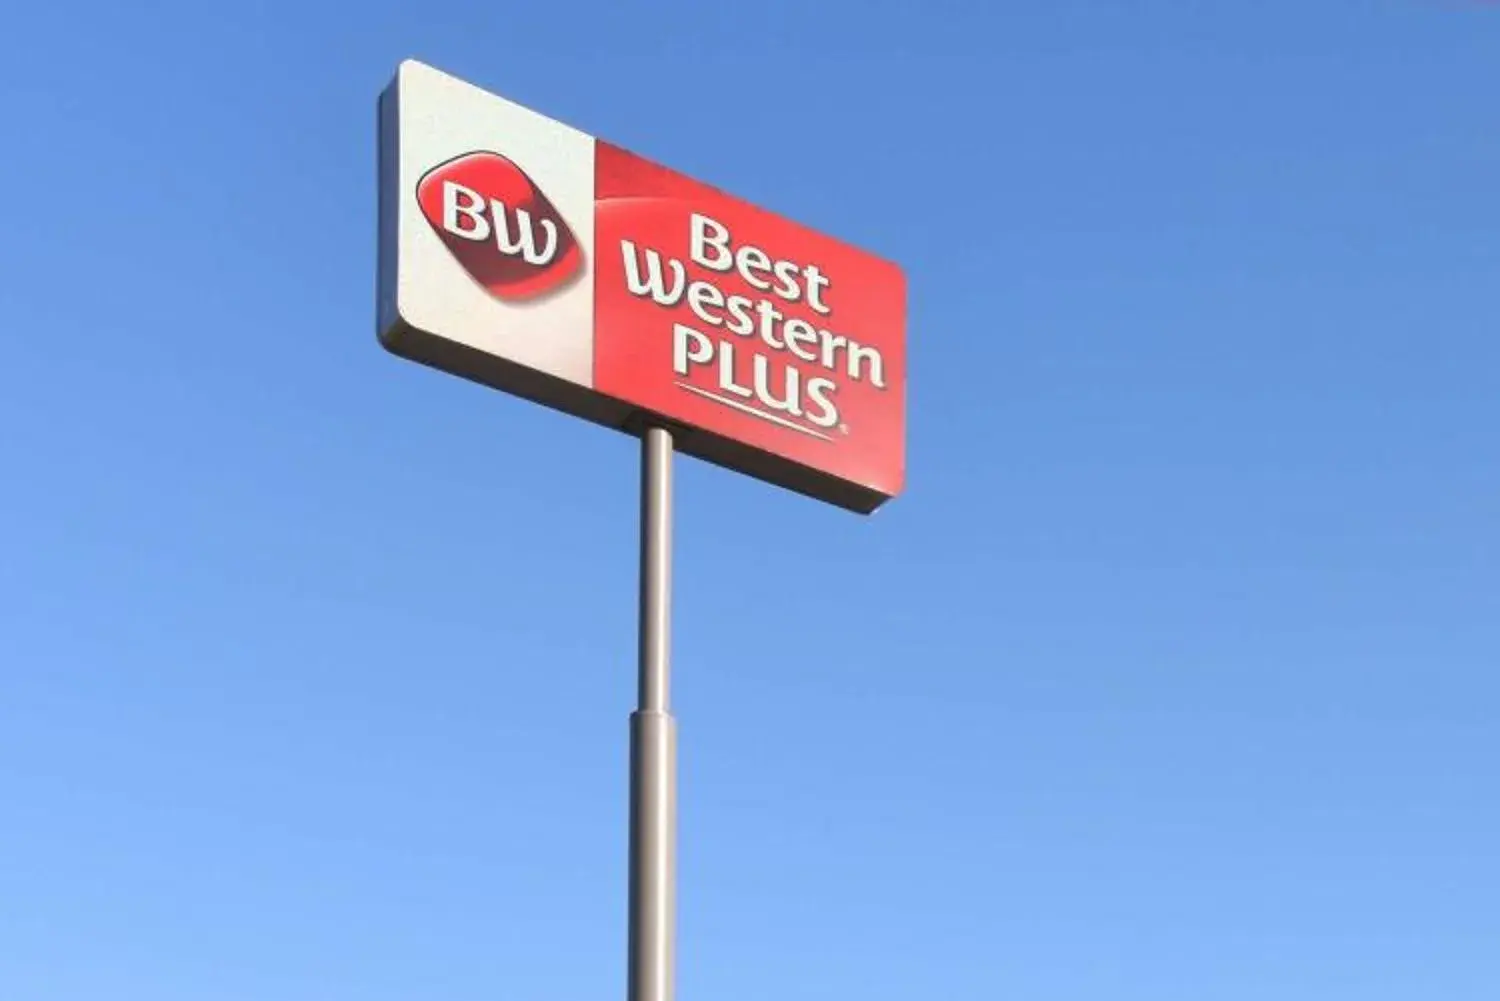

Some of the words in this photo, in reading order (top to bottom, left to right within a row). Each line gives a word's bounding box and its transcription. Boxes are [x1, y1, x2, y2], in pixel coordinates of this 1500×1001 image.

[442, 180, 557, 266] BW
[690, 212, 830, 313] Best
[620, 240, 886, 388] Western
[672, 323, 840, 428] PLUS
